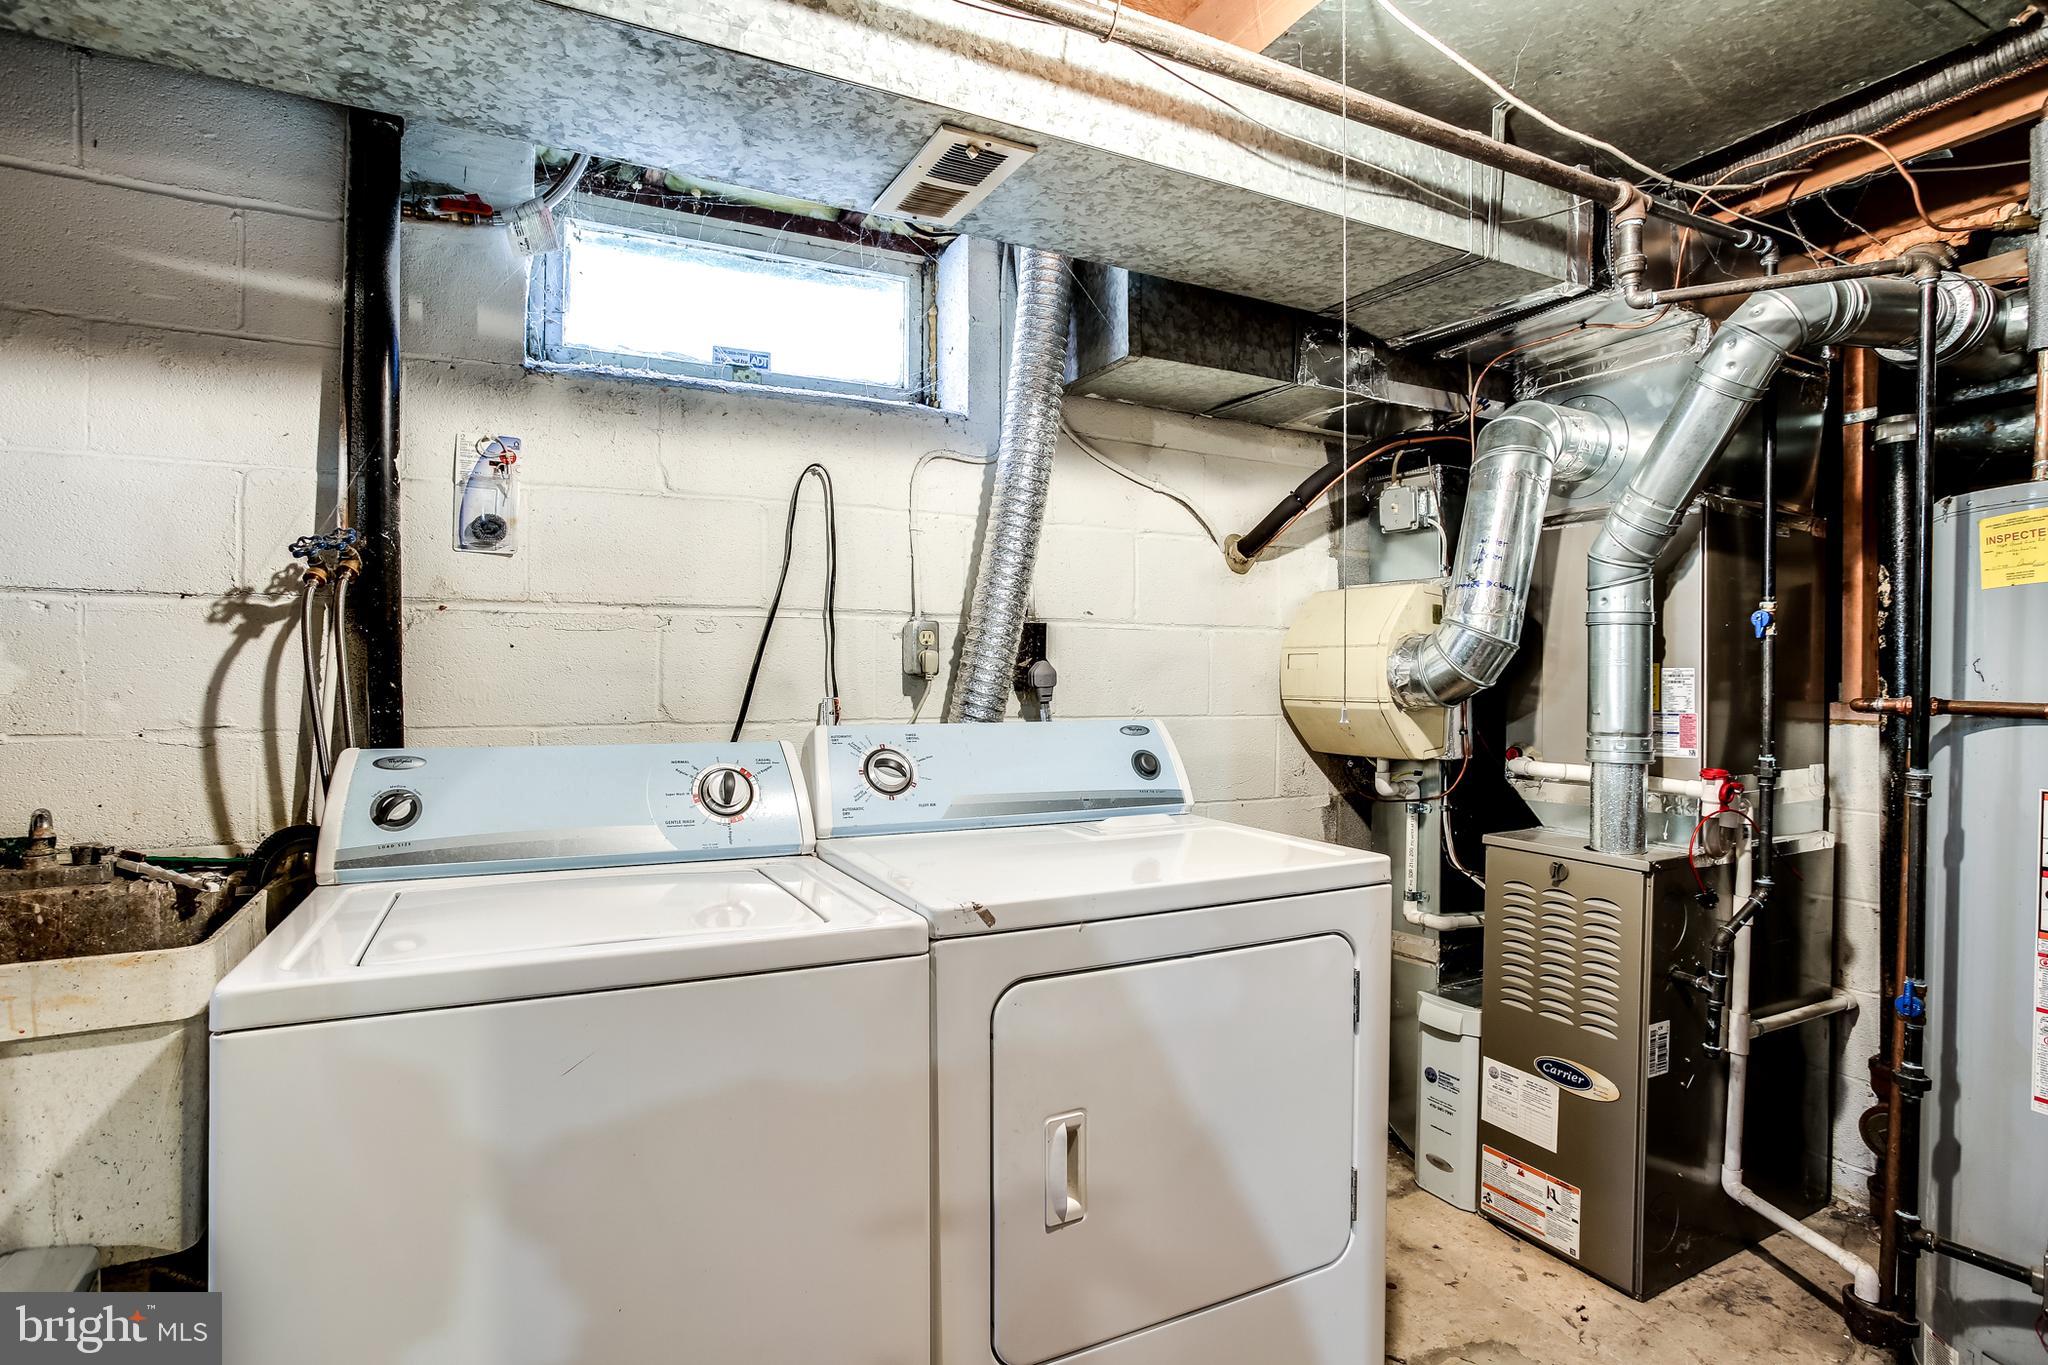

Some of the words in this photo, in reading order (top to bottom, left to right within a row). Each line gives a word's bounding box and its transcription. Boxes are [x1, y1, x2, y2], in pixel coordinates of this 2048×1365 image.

[751, 356, 769, 367] ADT
[1986, 527, 2048, 545] INSPECTE
[1542, 1062, 1585, 1084] Carrier
